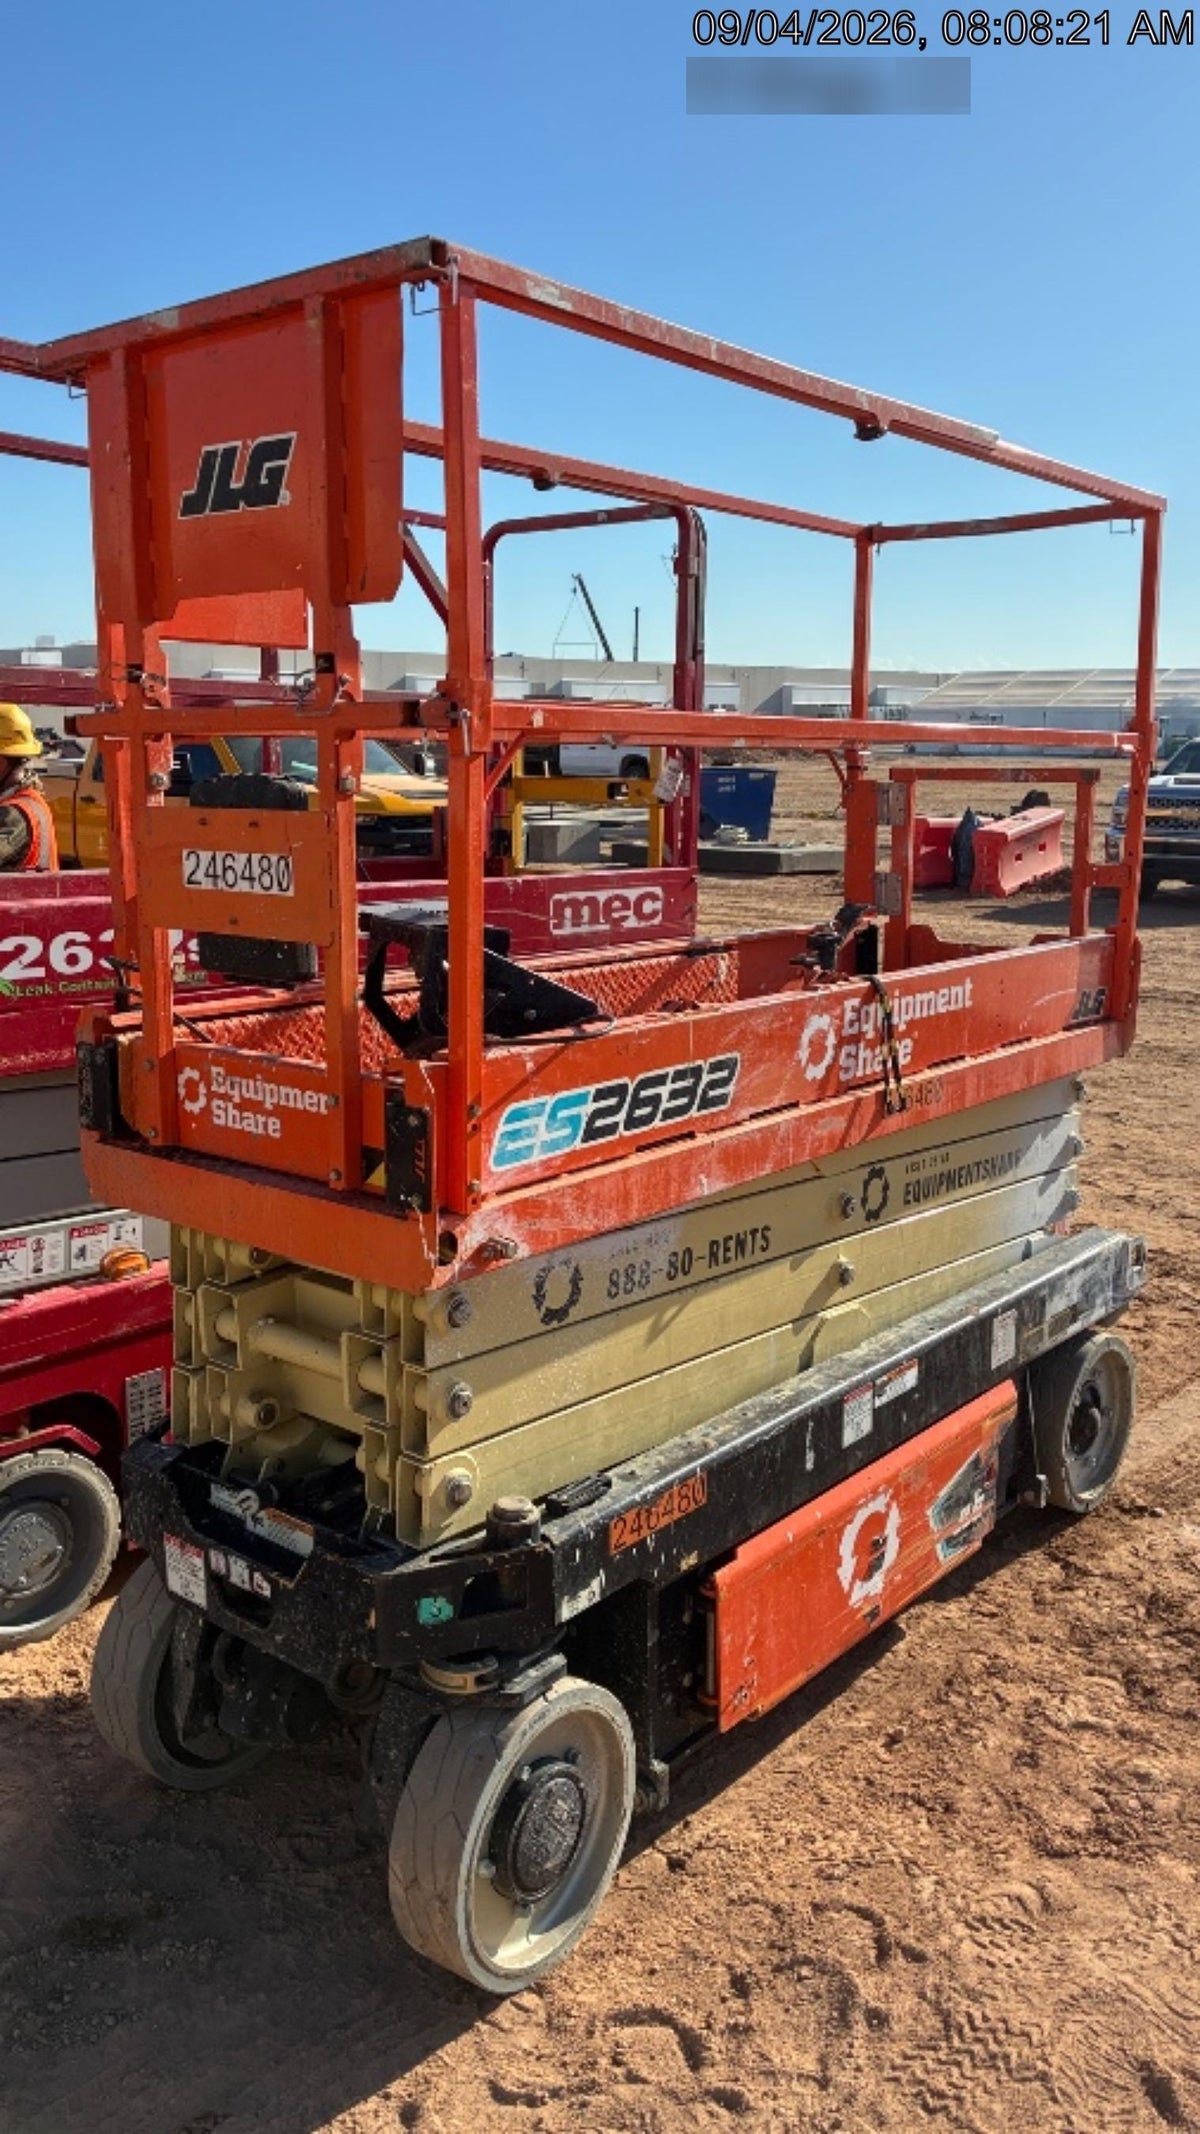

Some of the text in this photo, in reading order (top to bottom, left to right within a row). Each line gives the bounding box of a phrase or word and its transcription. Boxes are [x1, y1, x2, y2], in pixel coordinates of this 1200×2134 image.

[178, 431, 297, 520] JLG
[185, 850, 292, 892] 246480
[550, 887, 663, 935] mec
[211, 1098, 281, 1138] Share
[490, 1053, 741, 1172] ES2632
[611, 1472, 707, 1551] 246480
